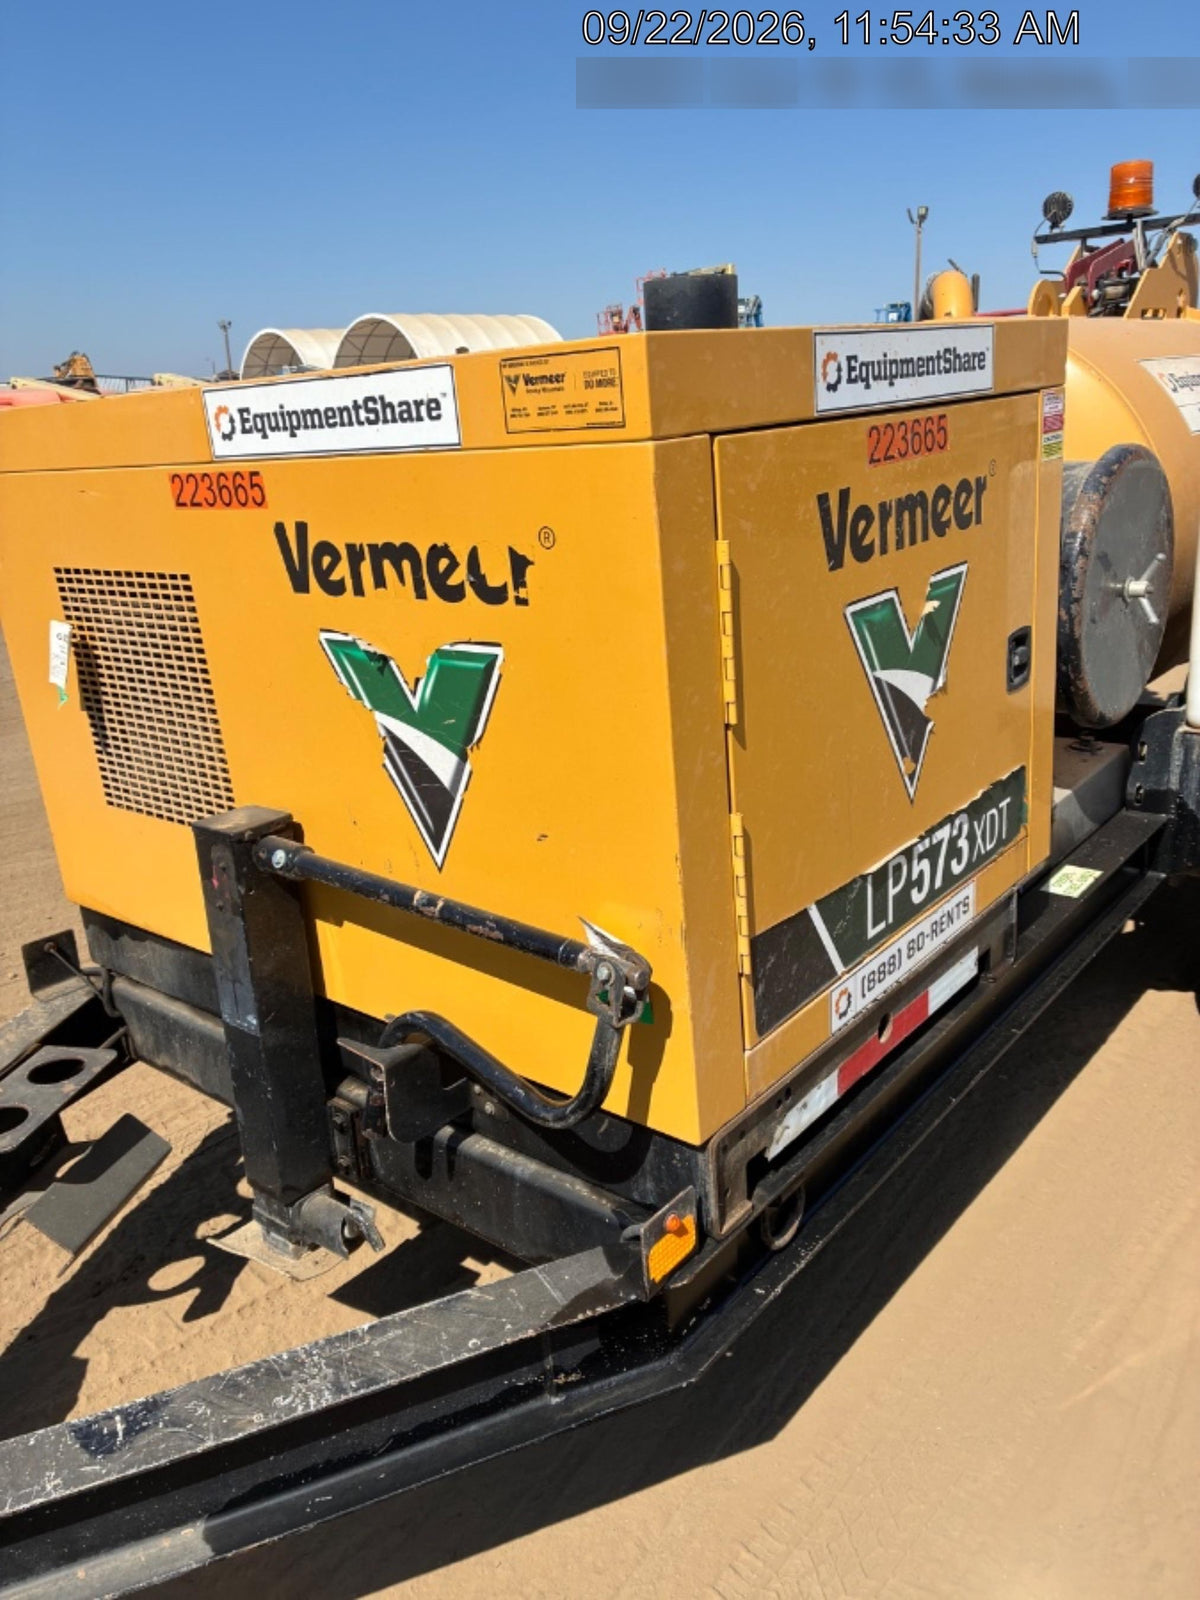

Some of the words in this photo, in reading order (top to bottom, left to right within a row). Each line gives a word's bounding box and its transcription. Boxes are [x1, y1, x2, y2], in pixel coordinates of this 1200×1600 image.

[523, 372, 565, 386] Vermeer
[845, 347, 986, 389] EquipmentShare
[240, 394, 442, 440] EquipmentShare
[868, 414, 948, 464] 223665
[171, 471, 266, 509] 223665
[817, 474, 988, 572] Vermeer
[860, 948, 903, 999] (888)
